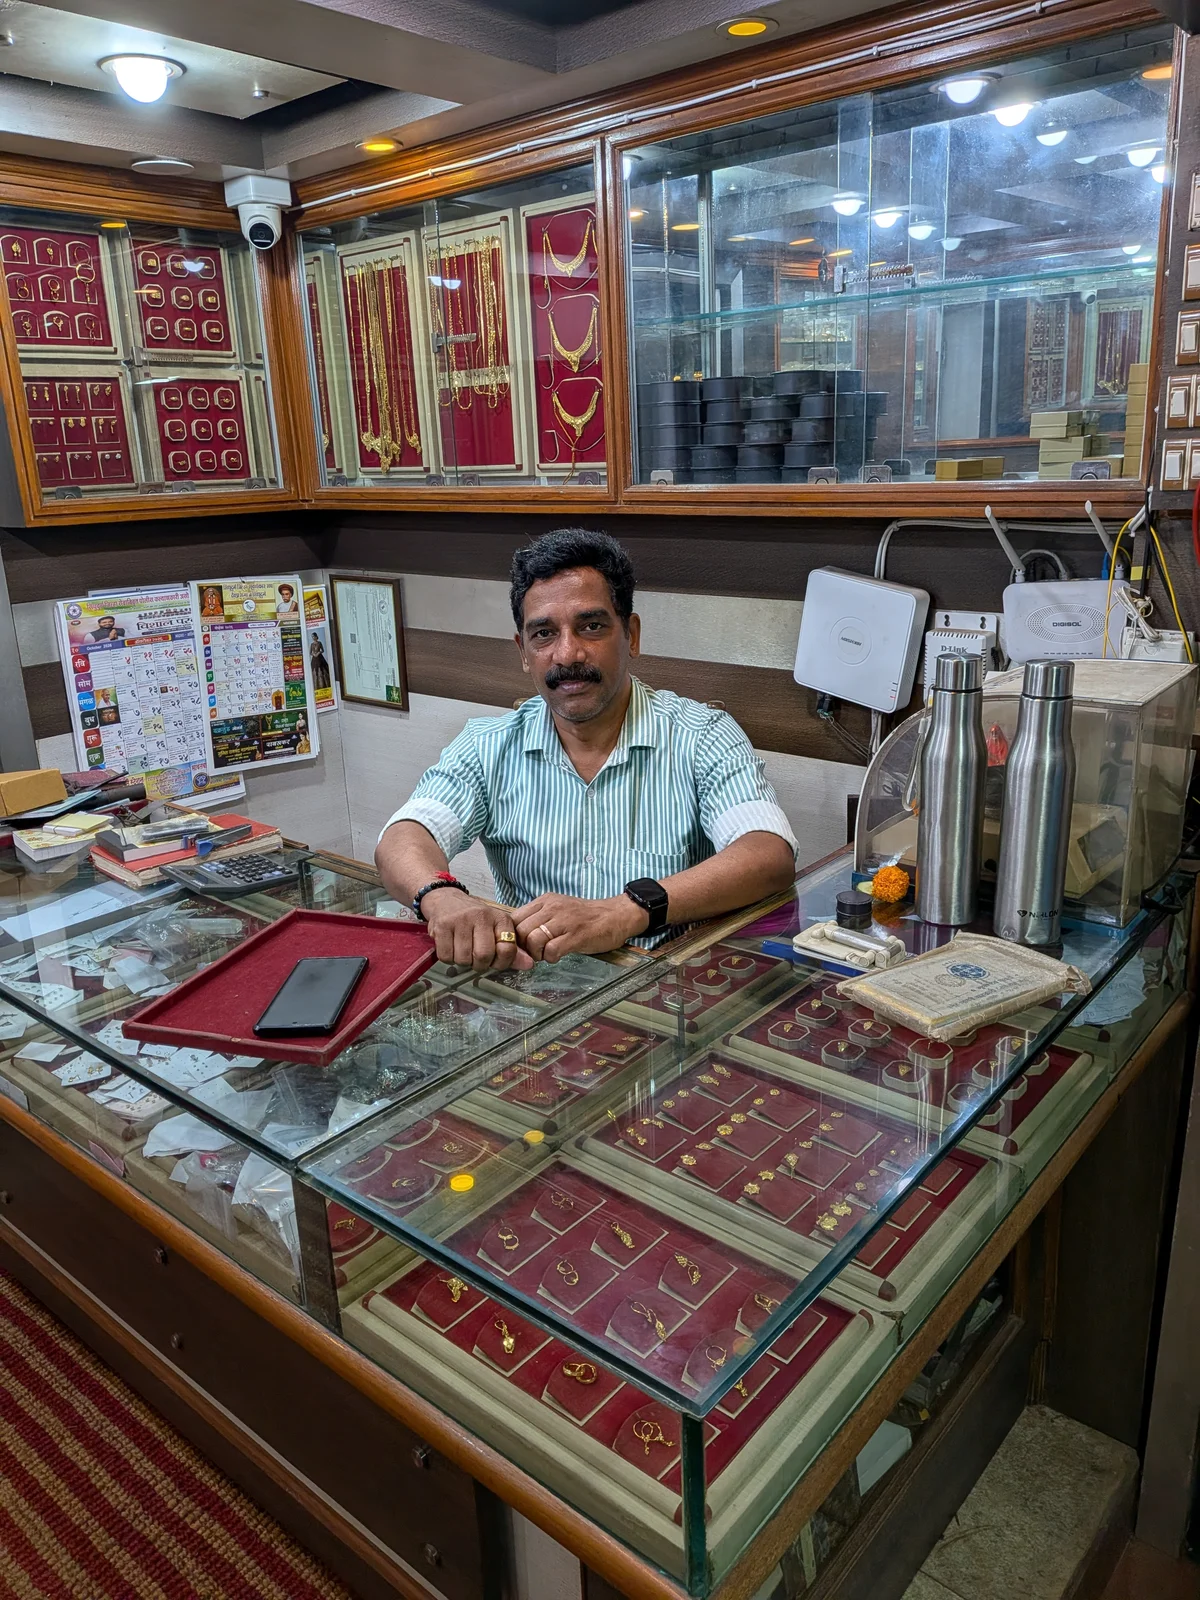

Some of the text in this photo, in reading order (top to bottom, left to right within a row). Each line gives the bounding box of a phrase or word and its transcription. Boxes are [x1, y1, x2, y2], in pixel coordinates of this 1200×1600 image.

[136, 620, 173, 631] विशाल
[941, 645, 969, 653] D-Link
[74, 658, 86, 669] रवि
[77, 680, 91, 689] सोम
[84, 716, 95, 726] बुध
[87, 734, 98, 744] गुरू
